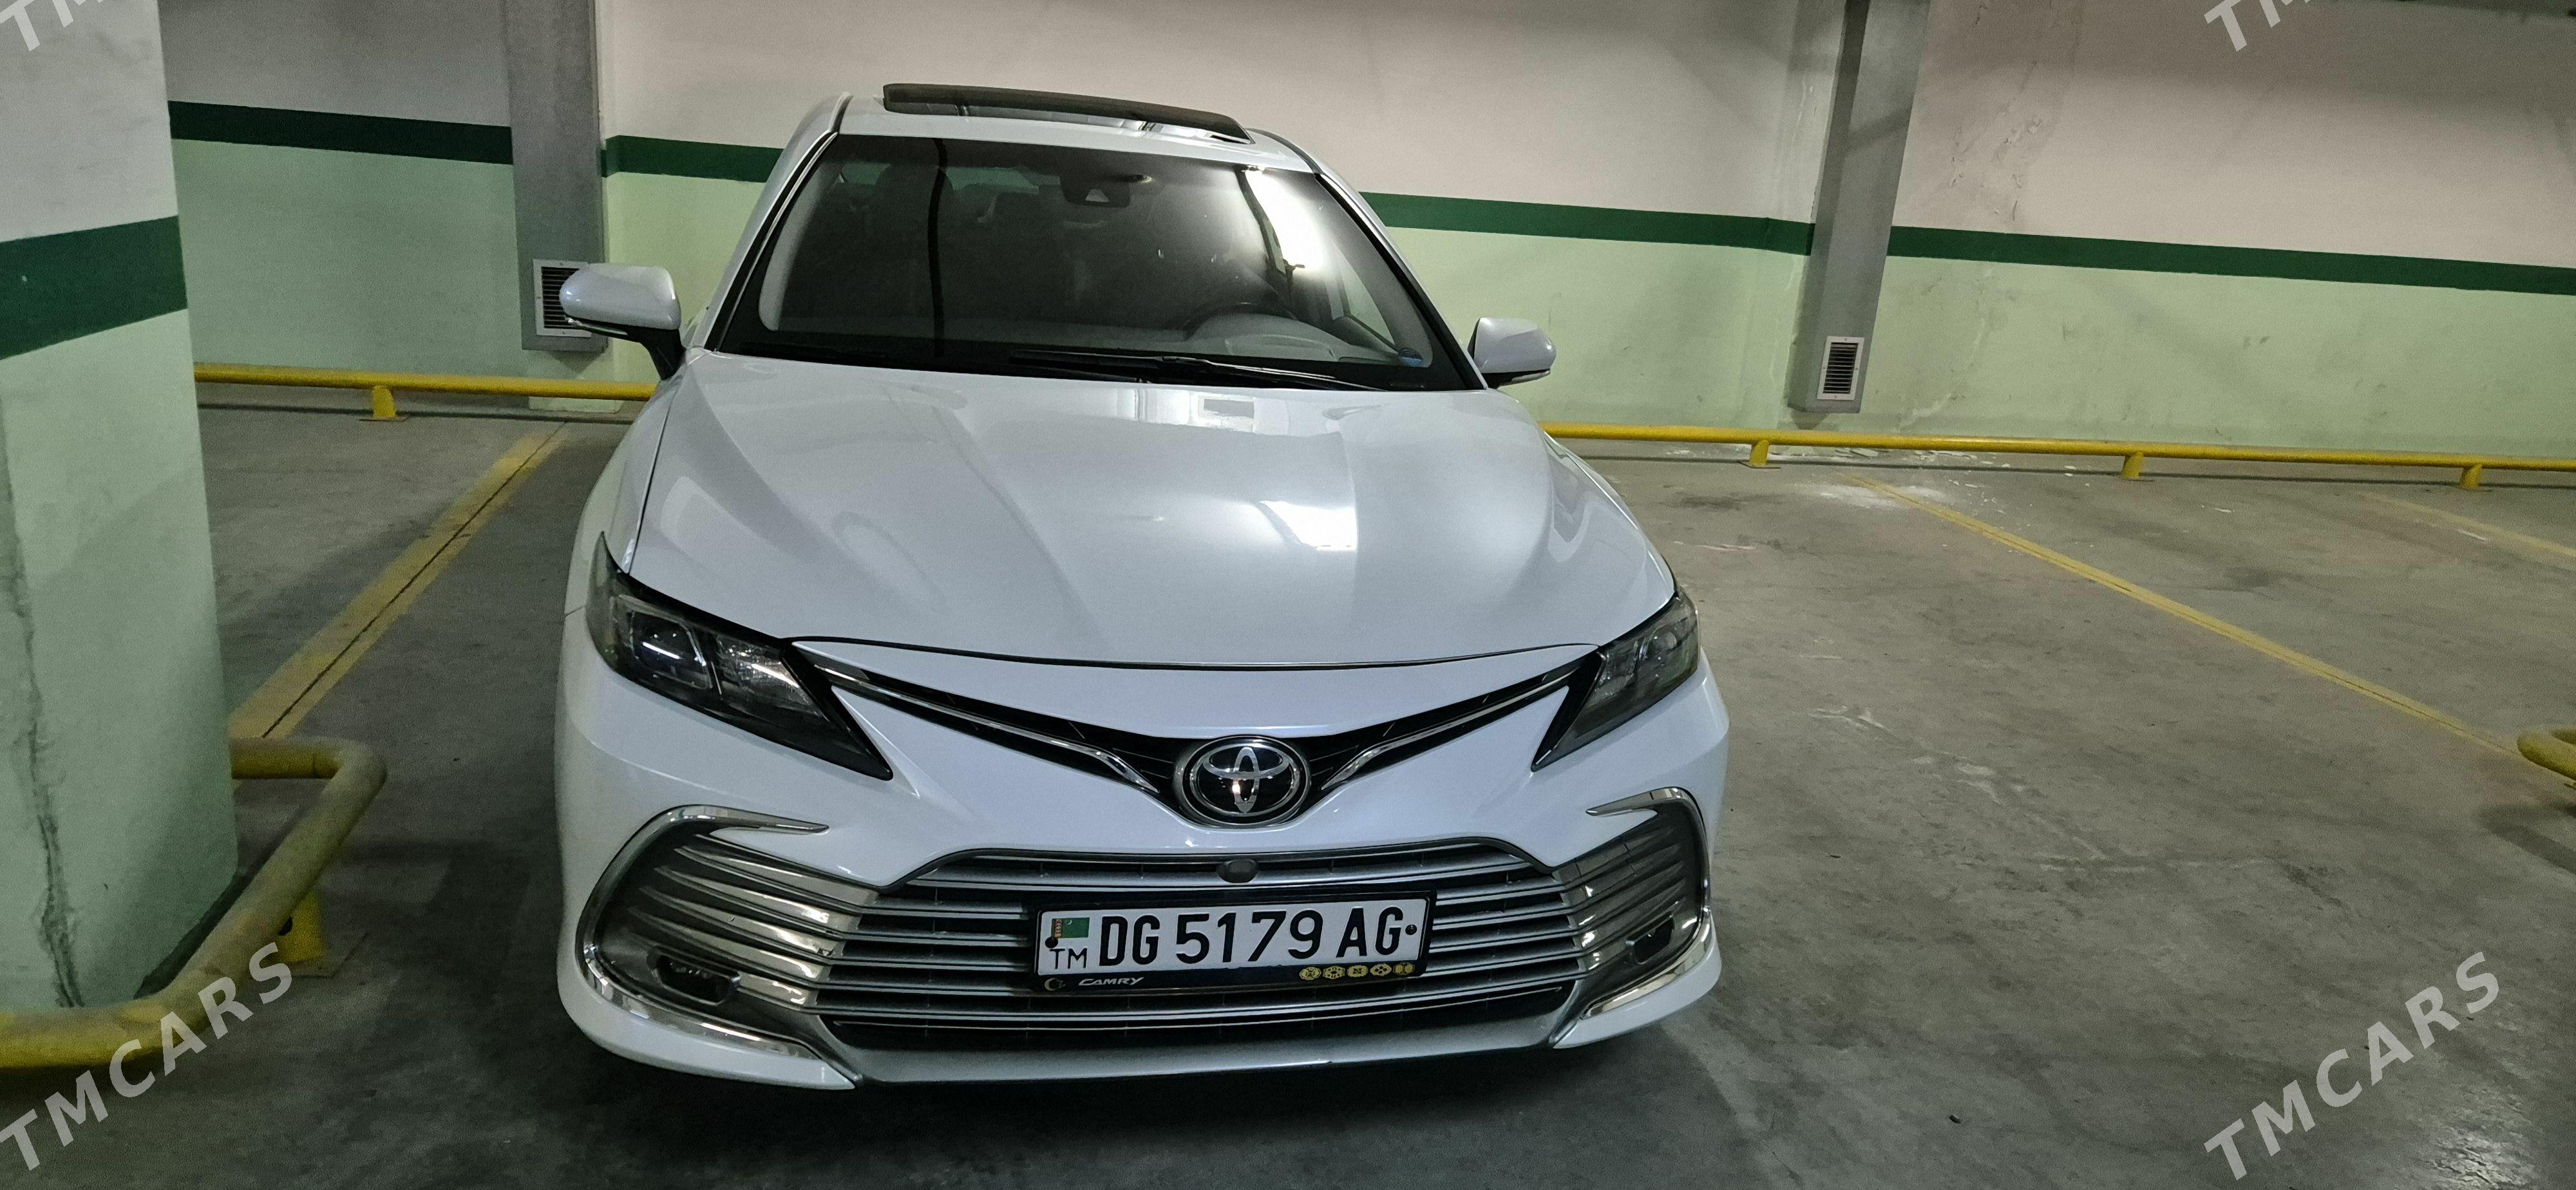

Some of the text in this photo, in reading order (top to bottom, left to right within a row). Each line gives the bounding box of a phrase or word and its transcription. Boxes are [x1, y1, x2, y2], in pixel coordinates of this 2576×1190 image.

[1100, 907, 1403, 966] DG 5179 AG
[1050, 948, 1088, 969] TM
[1079, 977, 1144, 986] CAMRY
